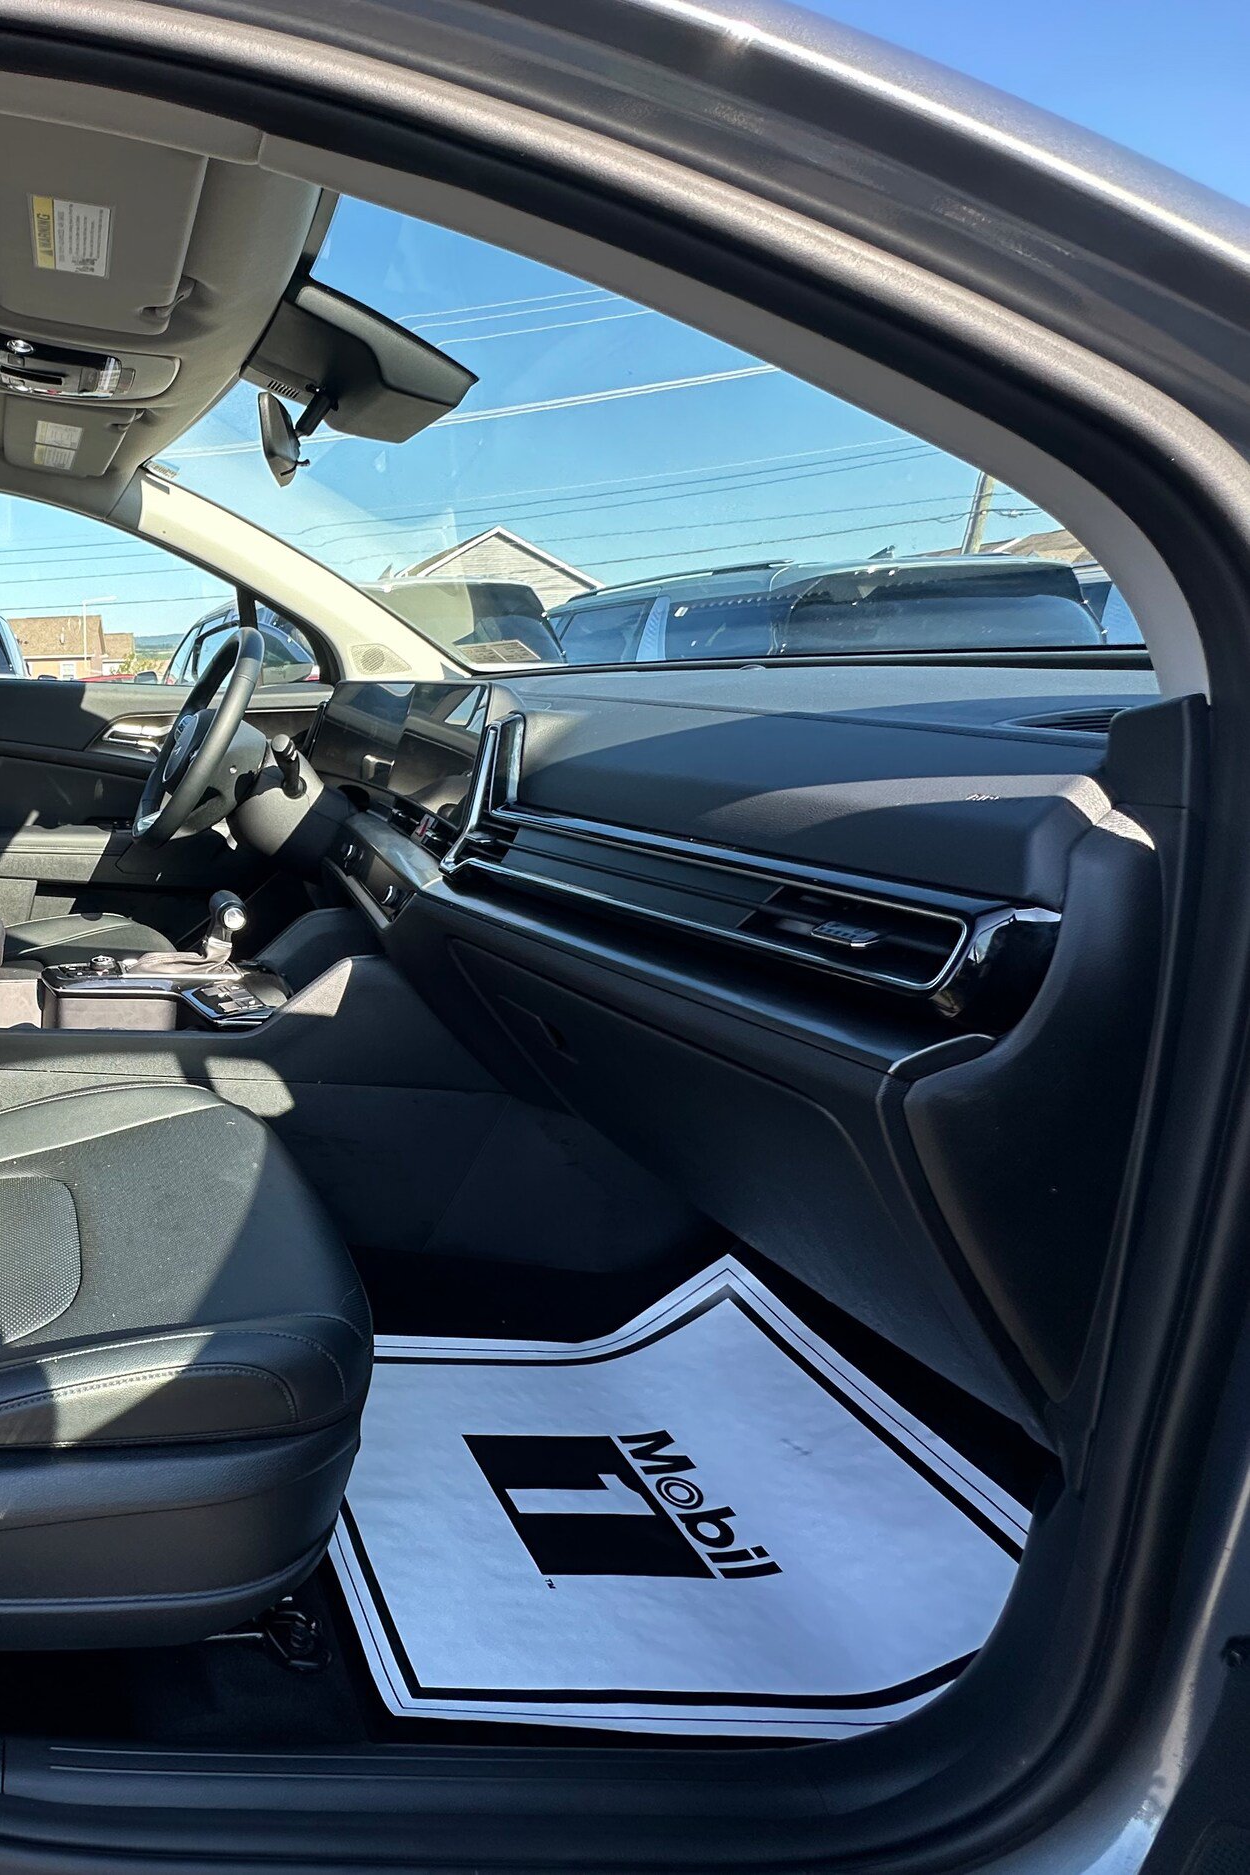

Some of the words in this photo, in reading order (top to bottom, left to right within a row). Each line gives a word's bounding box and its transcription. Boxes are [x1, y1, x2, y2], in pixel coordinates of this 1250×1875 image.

[37, 213, 52, 248] WARNING
[506, 1474, 656, 1515] 1
[617, 1429, 783, 1579] Mobil
